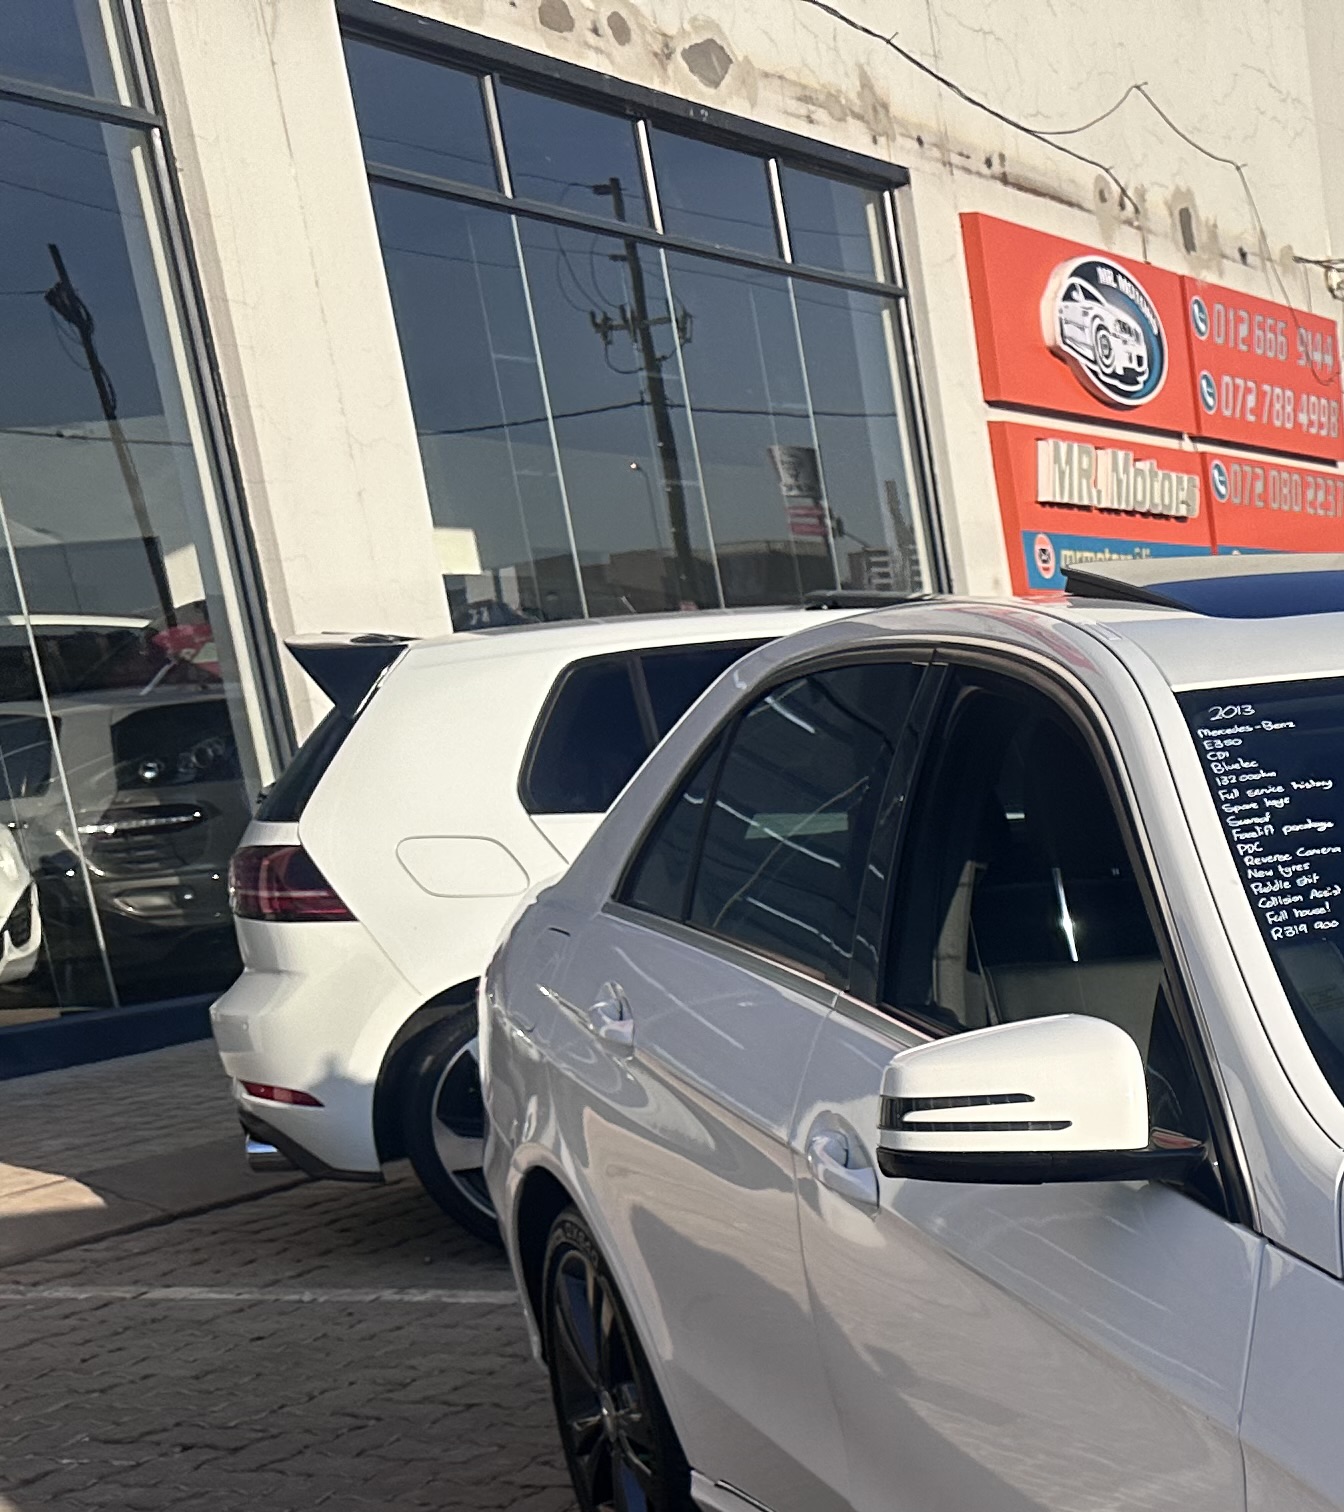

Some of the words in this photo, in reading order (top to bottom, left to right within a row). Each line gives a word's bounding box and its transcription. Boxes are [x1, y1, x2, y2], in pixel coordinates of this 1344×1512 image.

[1213, 302, 1249, 352] 012
[1254, 314, 1288, 361] 666
[1221, 375, 1257, 422] 072
[1262, 384, 1295, 430] 788
[1298, 393, 1339, 438] 4998
[1043, 438, 1101, 507] MR.
[1106, 449, 1200, 518] Motors
[1230, 463, 1264, 507] 072
[1270, 468, 1302, 512] 080
[1208, 704, 1255, 721] 2013
[1203, 739, 1242, 750] E350
[1207, 751, 1230, 761] CDI
[1218, 788, 1239, 801] Full
[1246, 785, 1285, 797] service
[1290, 780, 1334, 790] history
[1221, 802, 1259, 813] Spare
[1263, 797, 1290, 808] keys
[1226, 812, 1271, 827] Sunroof
[1282, 818, 1335, 835] package
[1236, 842, 1263, 855] PDC
[1243, 853, 1293, 867] Reverse
[1296, 846, 1342, 857] Camera
[1247, 869, 1274, 879] New
[1277, 862, 1310, 877] tyres
[1257, 893, 1303, 908] Collision
[1309, 884, 1342, 900] Assist
[1265, 910, 1289, 925] Full
[1293, 901, 1331, 918] house!
[1270, 923, 1309, 941] R319
[1313, 920, 1340, 930] 900
